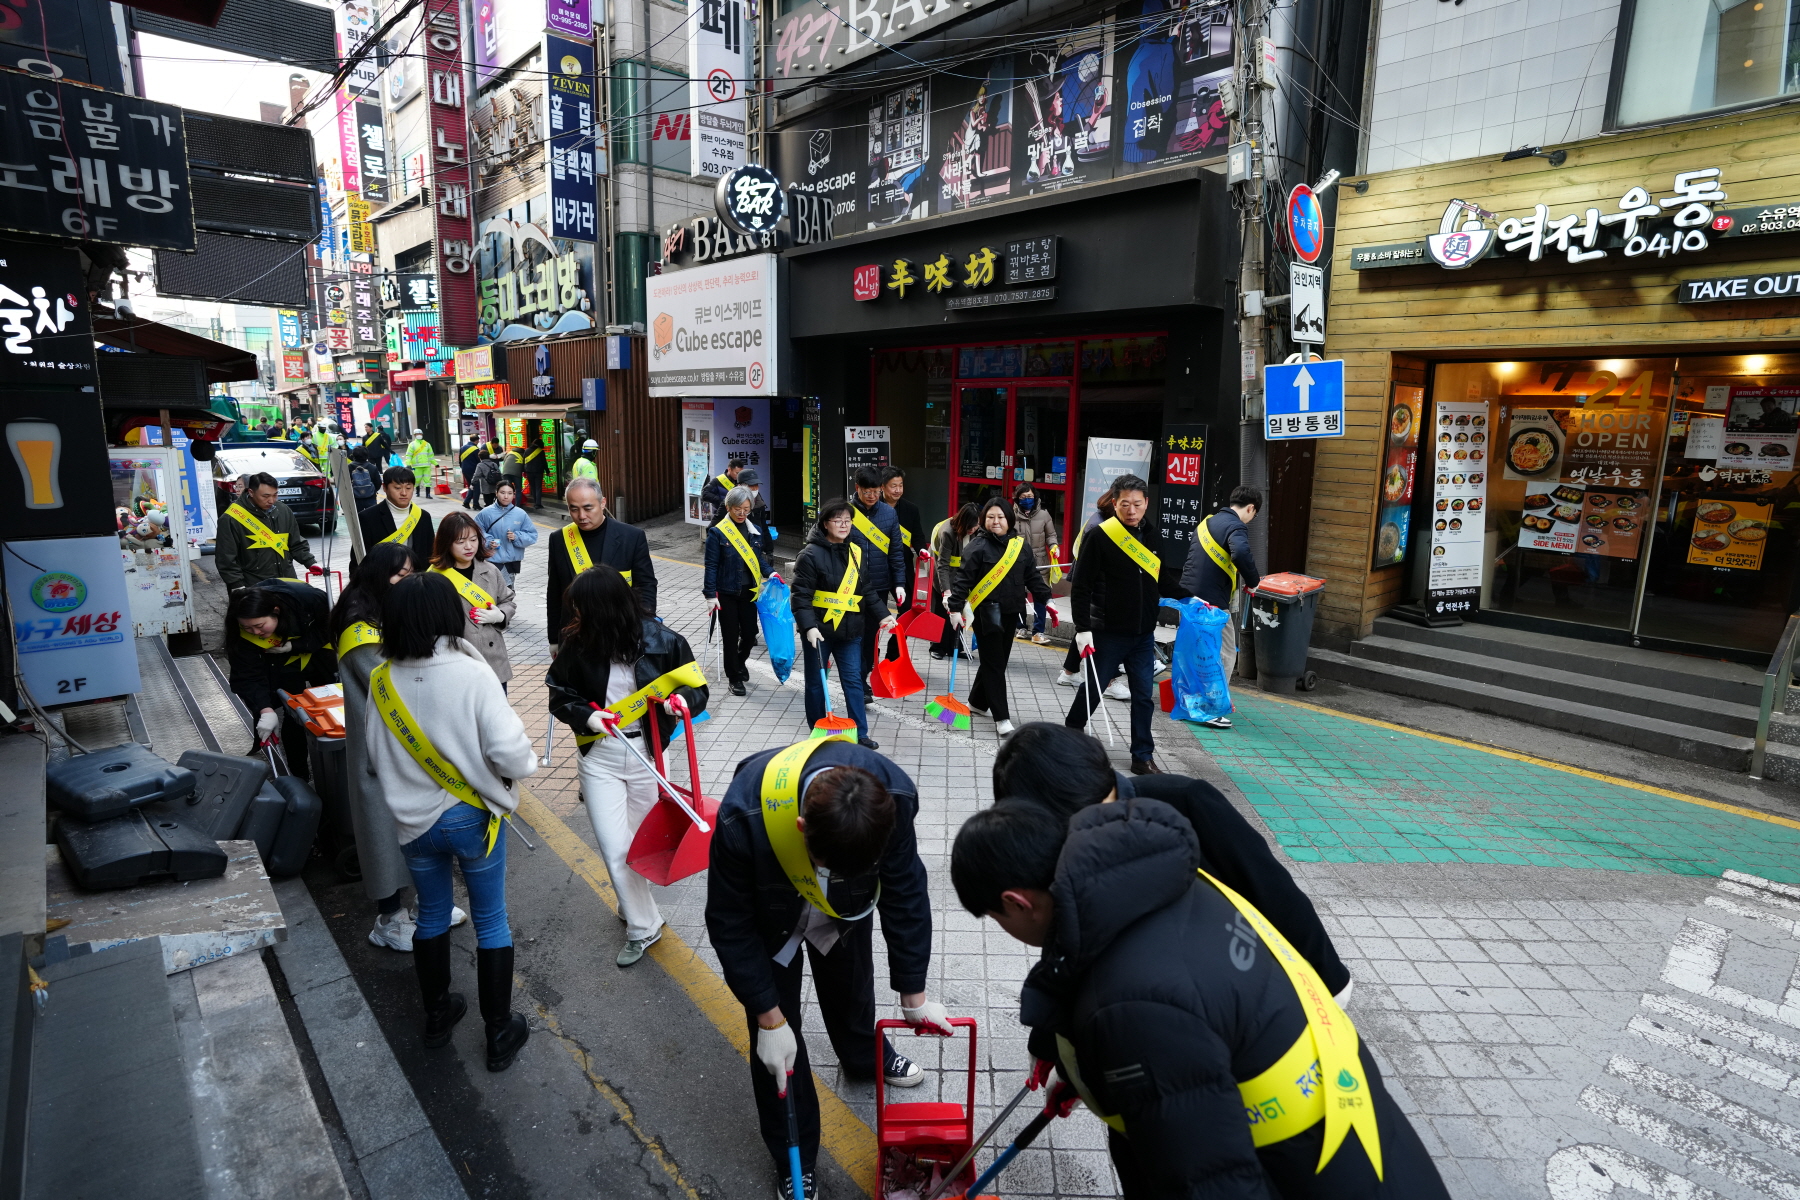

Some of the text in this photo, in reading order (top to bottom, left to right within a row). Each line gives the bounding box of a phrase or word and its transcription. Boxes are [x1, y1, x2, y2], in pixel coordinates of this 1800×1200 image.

[712, 75, 731, 95] 2F
[1130, 94, 1172, 111] Obsession
[0, 90, 177, 150] 음불가
[700, 115, 744, 134] 방탈출 두뇌게임
[1133, 113, 1164, 139] 집착
[361, 124, 386, 178] 첼로
[700, 133, 745, 150] 큐브 이스케이프
[1028, 131, 1089, 159] 마녀의 꿈
[711, 147, 734, 160] 수유점
[552, 145, 593, 186] 블랙잭
[735, 175, 776, 200] 427
[816, 171, 856, 194] escape
[942, 179, 972, 199] 천사들
[736, 195, 774, 216] BAR
[870, 187, 905, 205] 더 큐브
[61, 208, 118, 236] 6F
[554, 197, 595, 235] 바카라
[797, 193, 834, 244] BAR
[1293, 215, 1319, 233] 주차금지
[1499, 167, 1727, 263] 역전우동
[663, 228, 685, 262] 427
[762, 230, 777, 248] B1
[1010, 239, 1051, 254] 마라탕
[1624, 229, 1708, 259] 0410
[1010, 252, 1050, 267] 꿔바로우
[1356, 252, 1371, 262] 우동
[1378, 250, 1393, 261] 소바
[1393, 249, 1415, 260] 잘하는
[1415, 248, 1423, 258] 집
[1010, 265, 1050, 279] 전문점
[1293, 270, 1320, 289] 견인지역
[481, 251, 579, 325] 등대노래방
[1687, 274, 1800, 299] TAKE OUT
[695, 299, 762, 324] 큐브 이스케이프
[281, 317, 298, 347] 노래방
[330, 329, 349, 347] 꽃
[675, 327, 762, 352] Cube escape
[752, 369, 761, 382] 2F
[1583, 370, 1654, 412] 24
[1269, 414, 1339, 434] 일방통행
[1580, 414, 1651, 430] HOUR
[722, 437, 765, 446] Cube escape
[857, 429, 885, 439] 신미방
[1577, 432, 1649, 449] OPEN
[1570, 466, 1644, 487] 옛날우동
[1163, 497, 1199, 510] 마라탕
[1162, 513, 1198, 526] 꿔바로우
[1533, 540, 1573, 550] SIDE MENU
[1715, 556, 1756, 567] 더 맛있다!
[57, 678, 87, 694] 2F
[376, 676, 390, 704] 쓰레기
